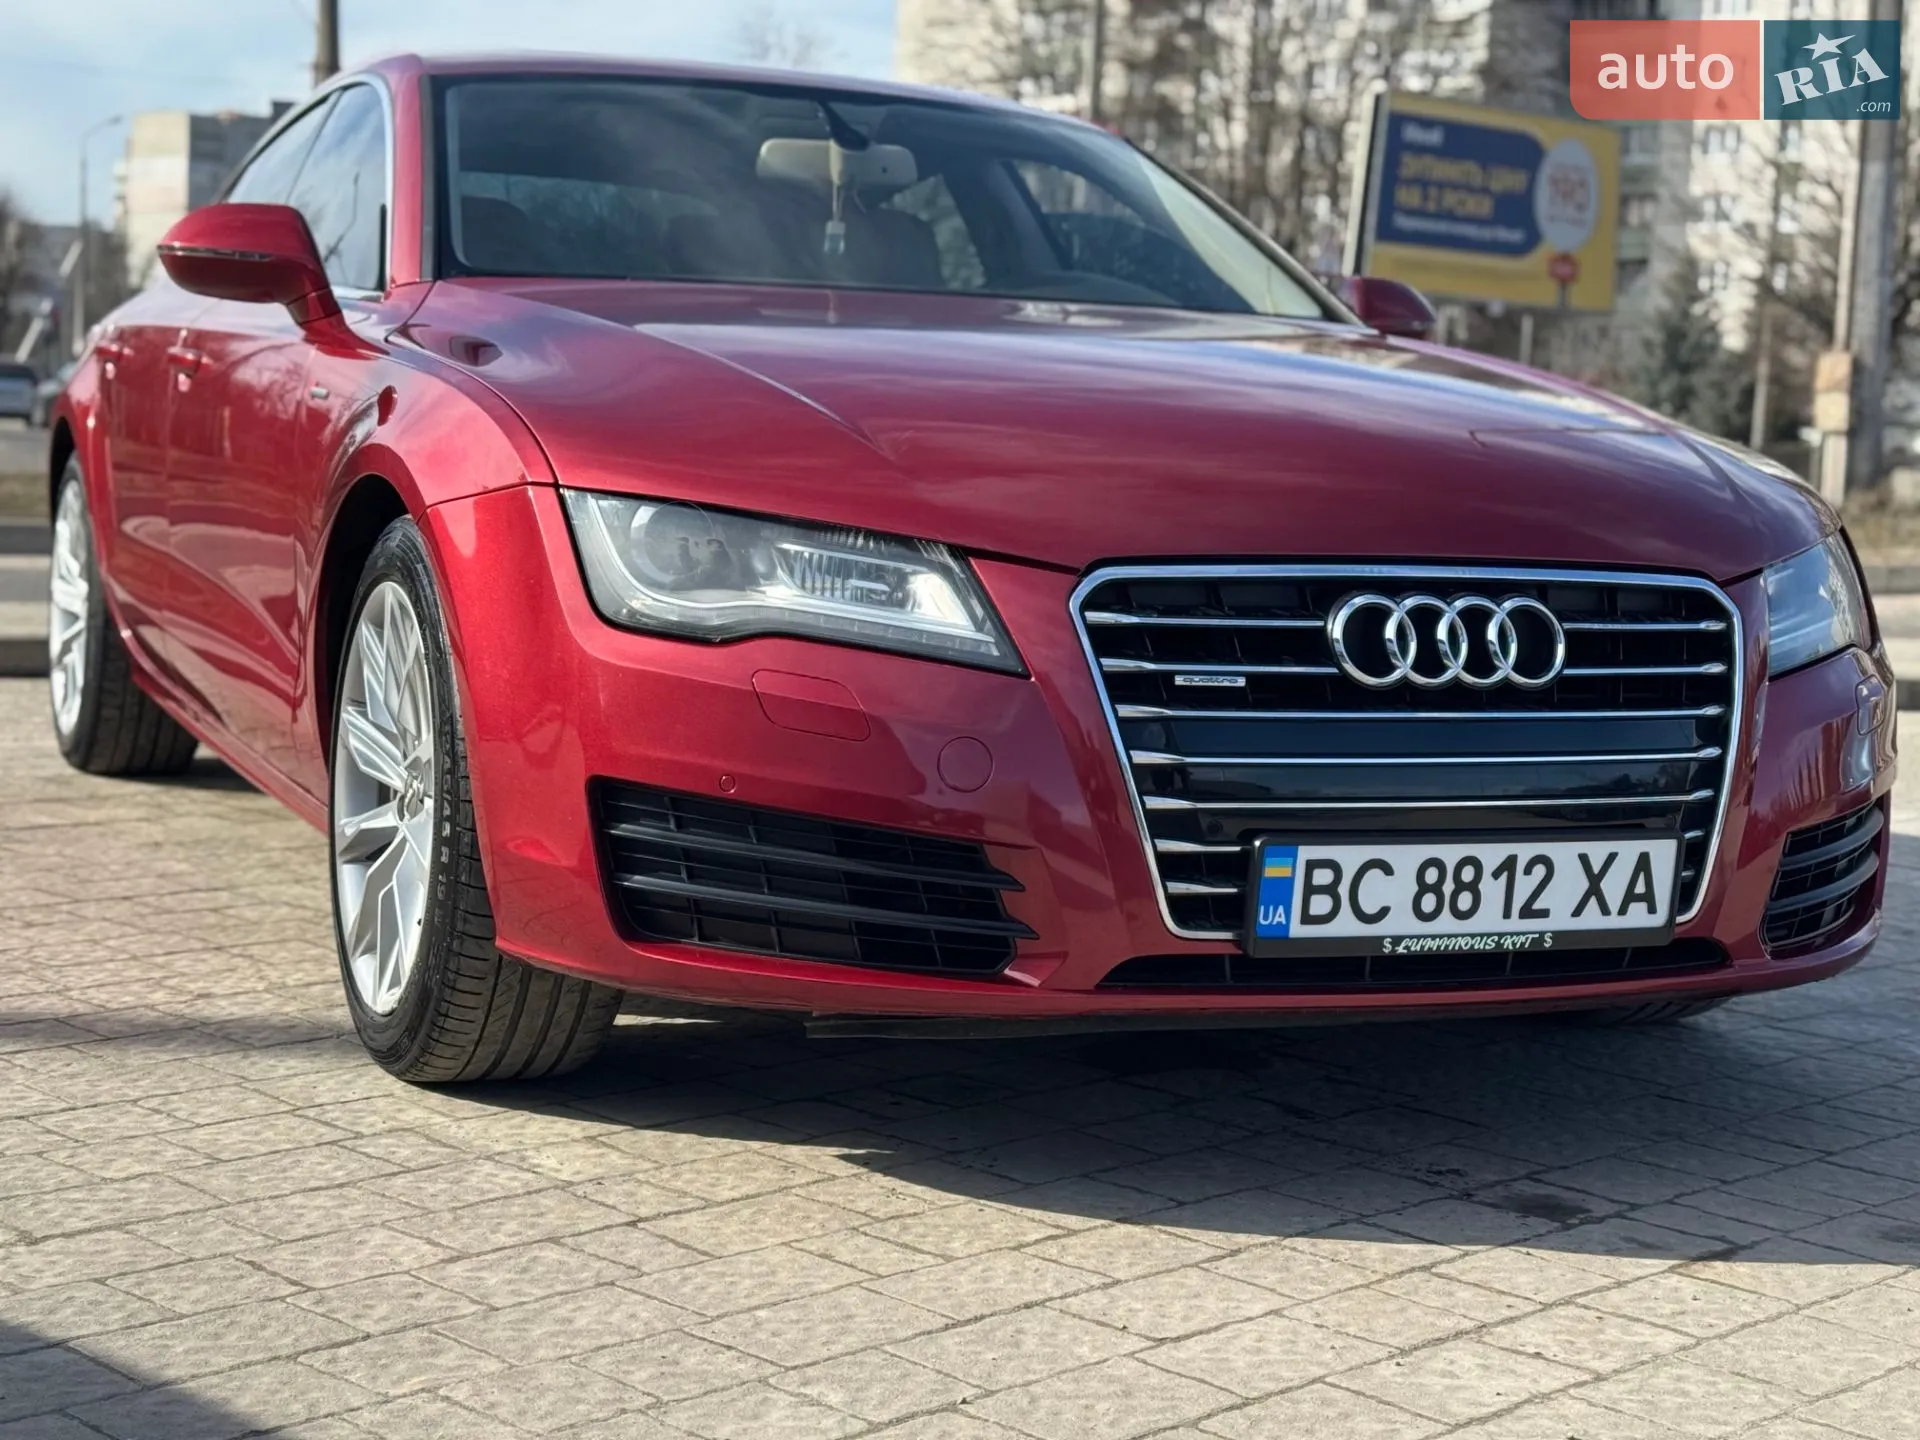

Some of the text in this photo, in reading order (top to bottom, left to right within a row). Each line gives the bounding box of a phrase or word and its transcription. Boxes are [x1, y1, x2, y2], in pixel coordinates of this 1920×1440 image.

[1182, 677, 1239, 685] quattro
[1300, 851, 1657, 926] BC 8812 XA
[1259, 904, 1287, 926] UA
[1500, 933, 1540, 950] KIT
